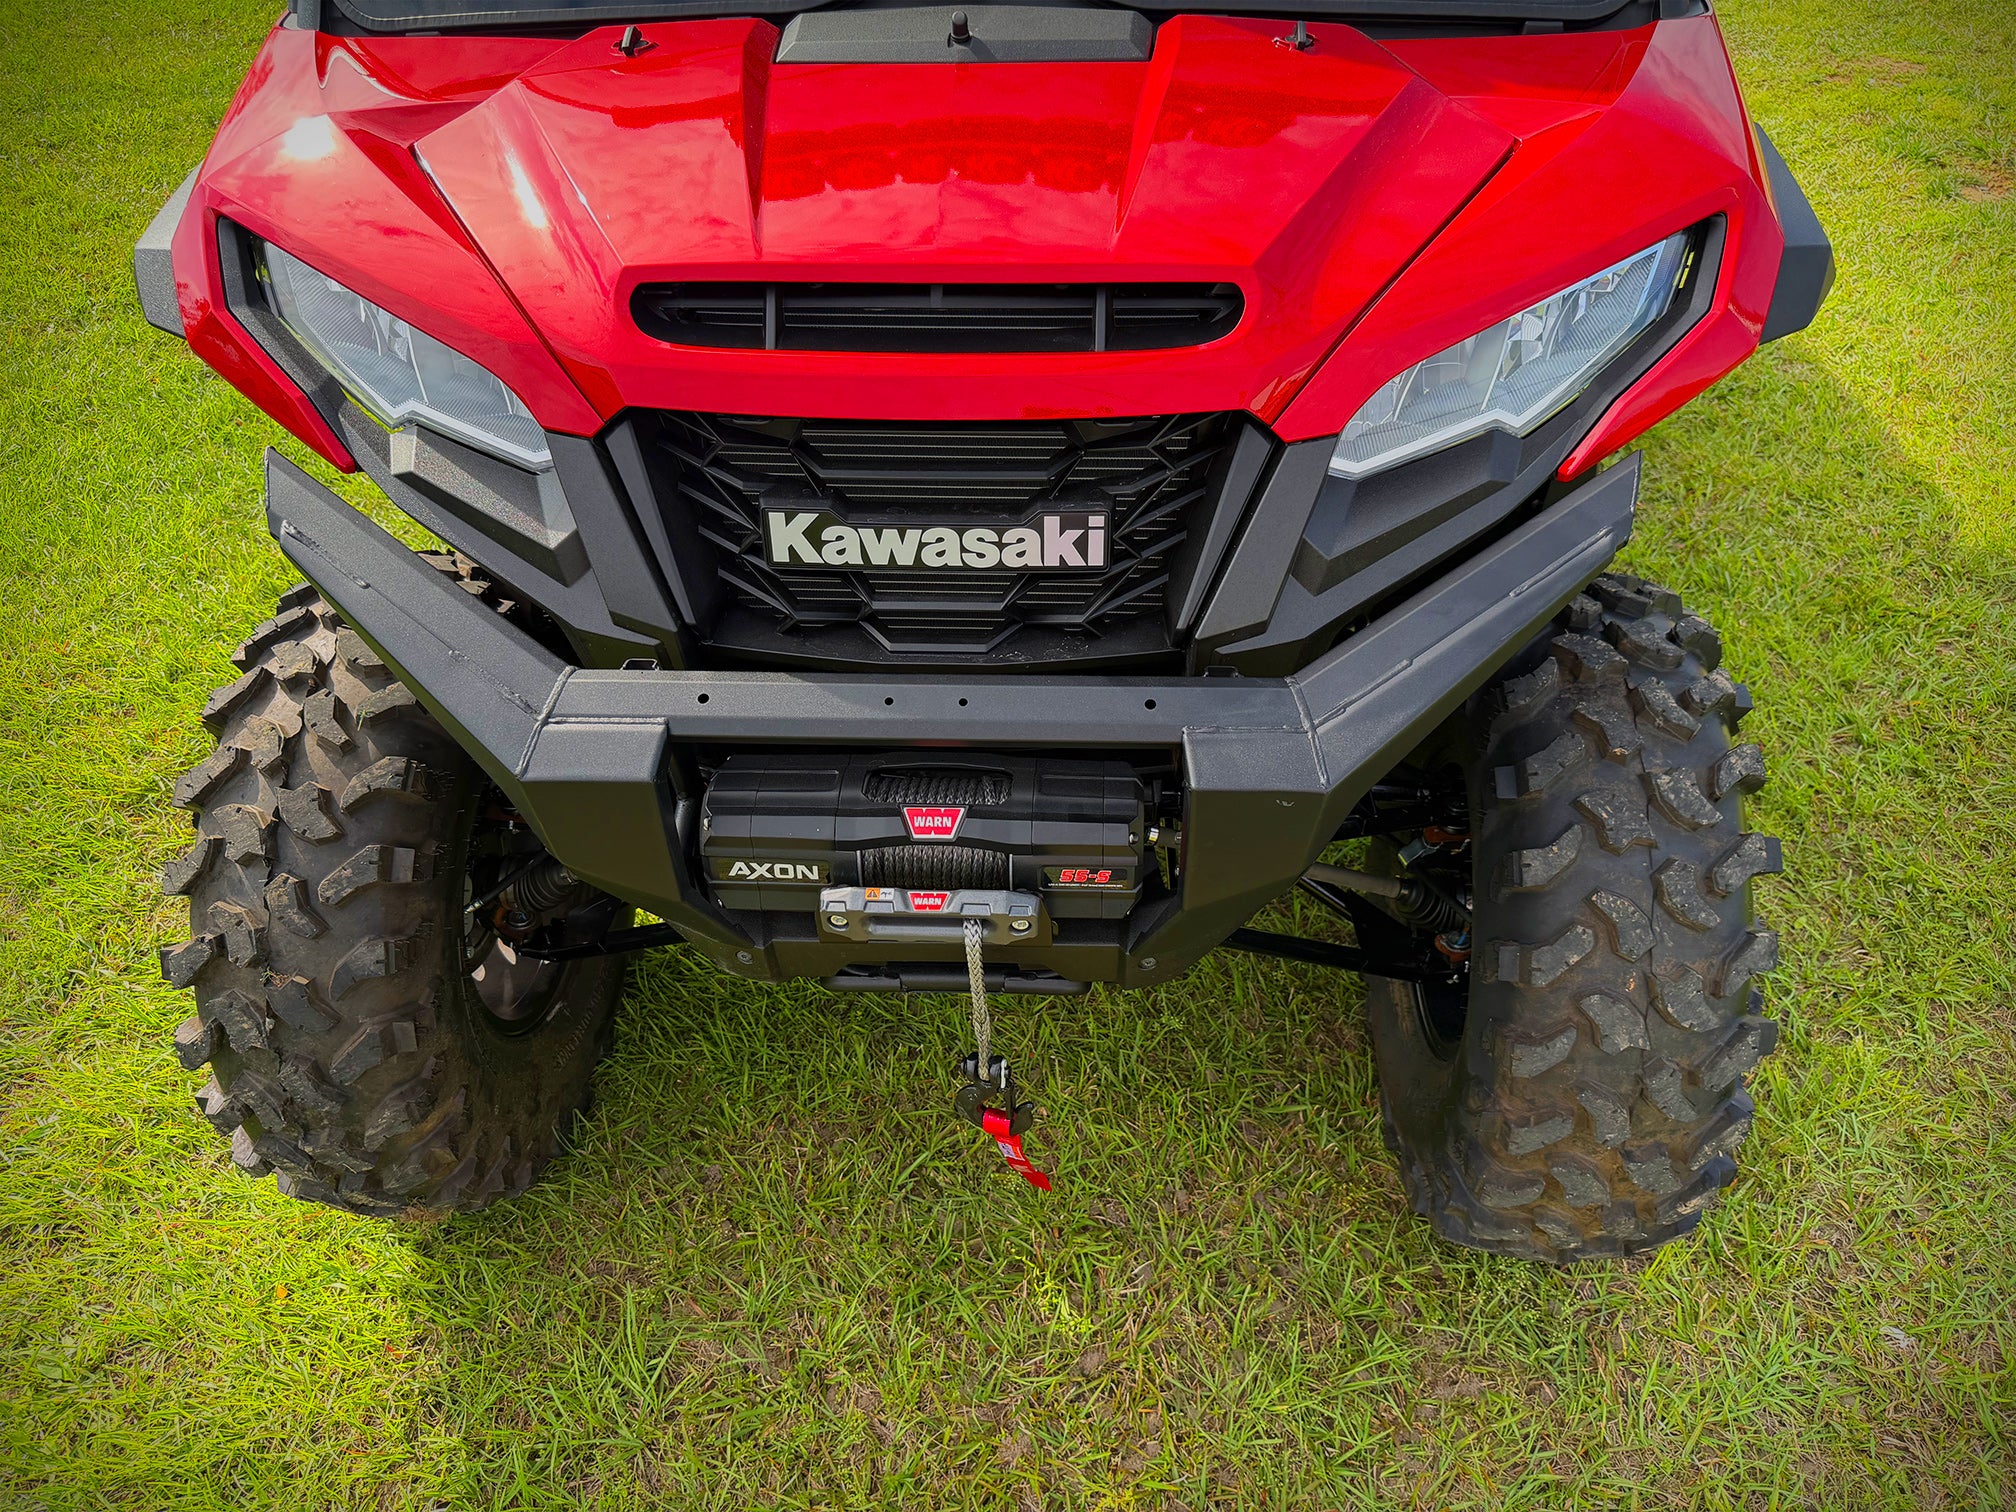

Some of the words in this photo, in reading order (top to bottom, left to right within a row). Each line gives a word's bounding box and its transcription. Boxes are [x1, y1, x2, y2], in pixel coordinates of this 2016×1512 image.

[768, 511, 1105, 568] Kawasaki
[913, 816, 952, 828] WARN
[728, 861, 820, 880] AXON
[914, 897, 942, 906] WARN
